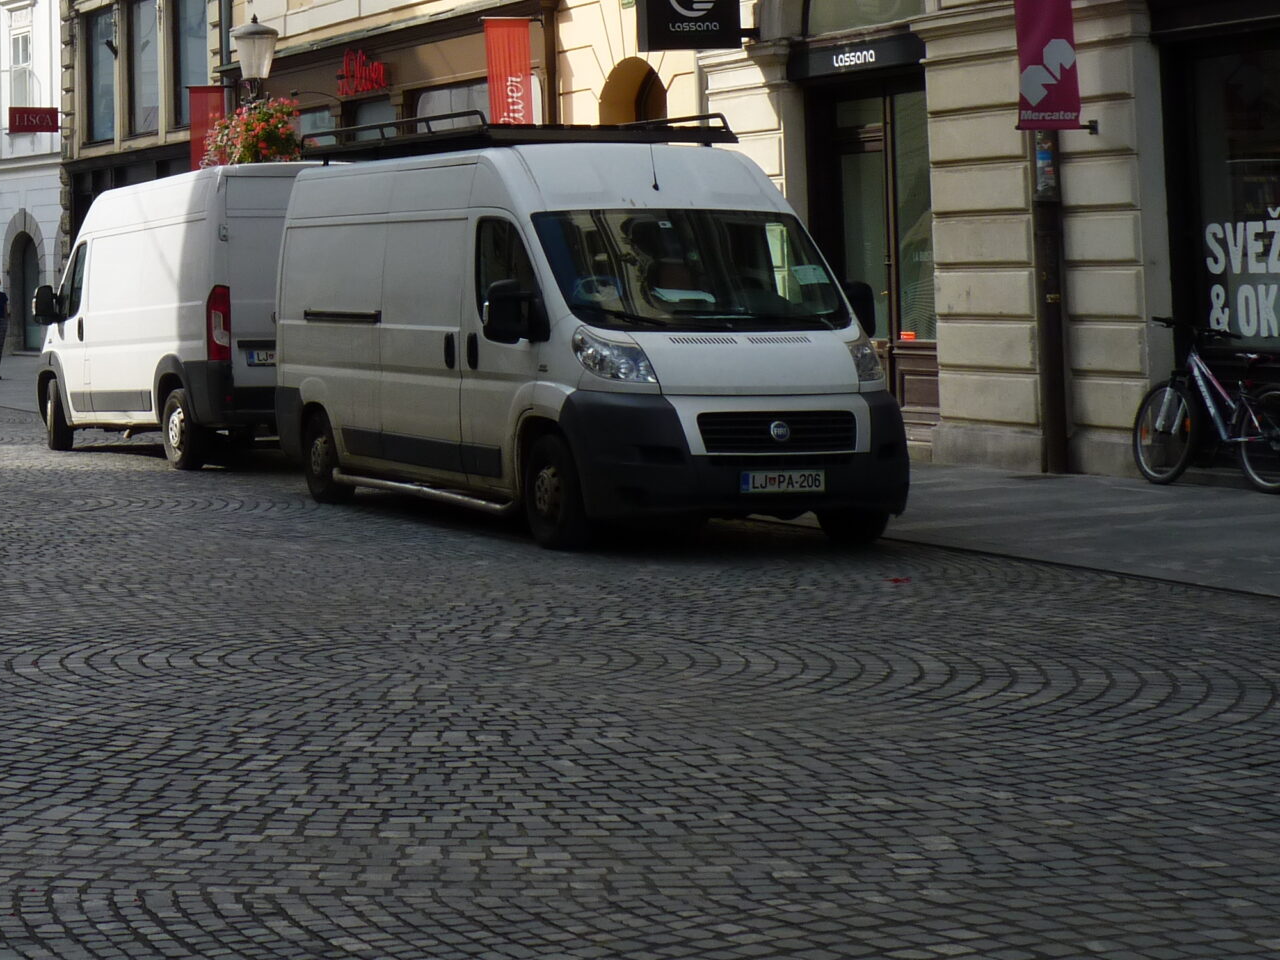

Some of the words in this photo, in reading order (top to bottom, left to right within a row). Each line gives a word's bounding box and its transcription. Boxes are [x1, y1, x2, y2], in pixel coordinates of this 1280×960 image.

[15, 113, 53, 126] LISCA
[1020, 110, 1078, 120] Mercator
[1209, 284, 1229, 333] &
[752, 474, 768, 490] LJ
[777, 473, 821, 489] PA-206
